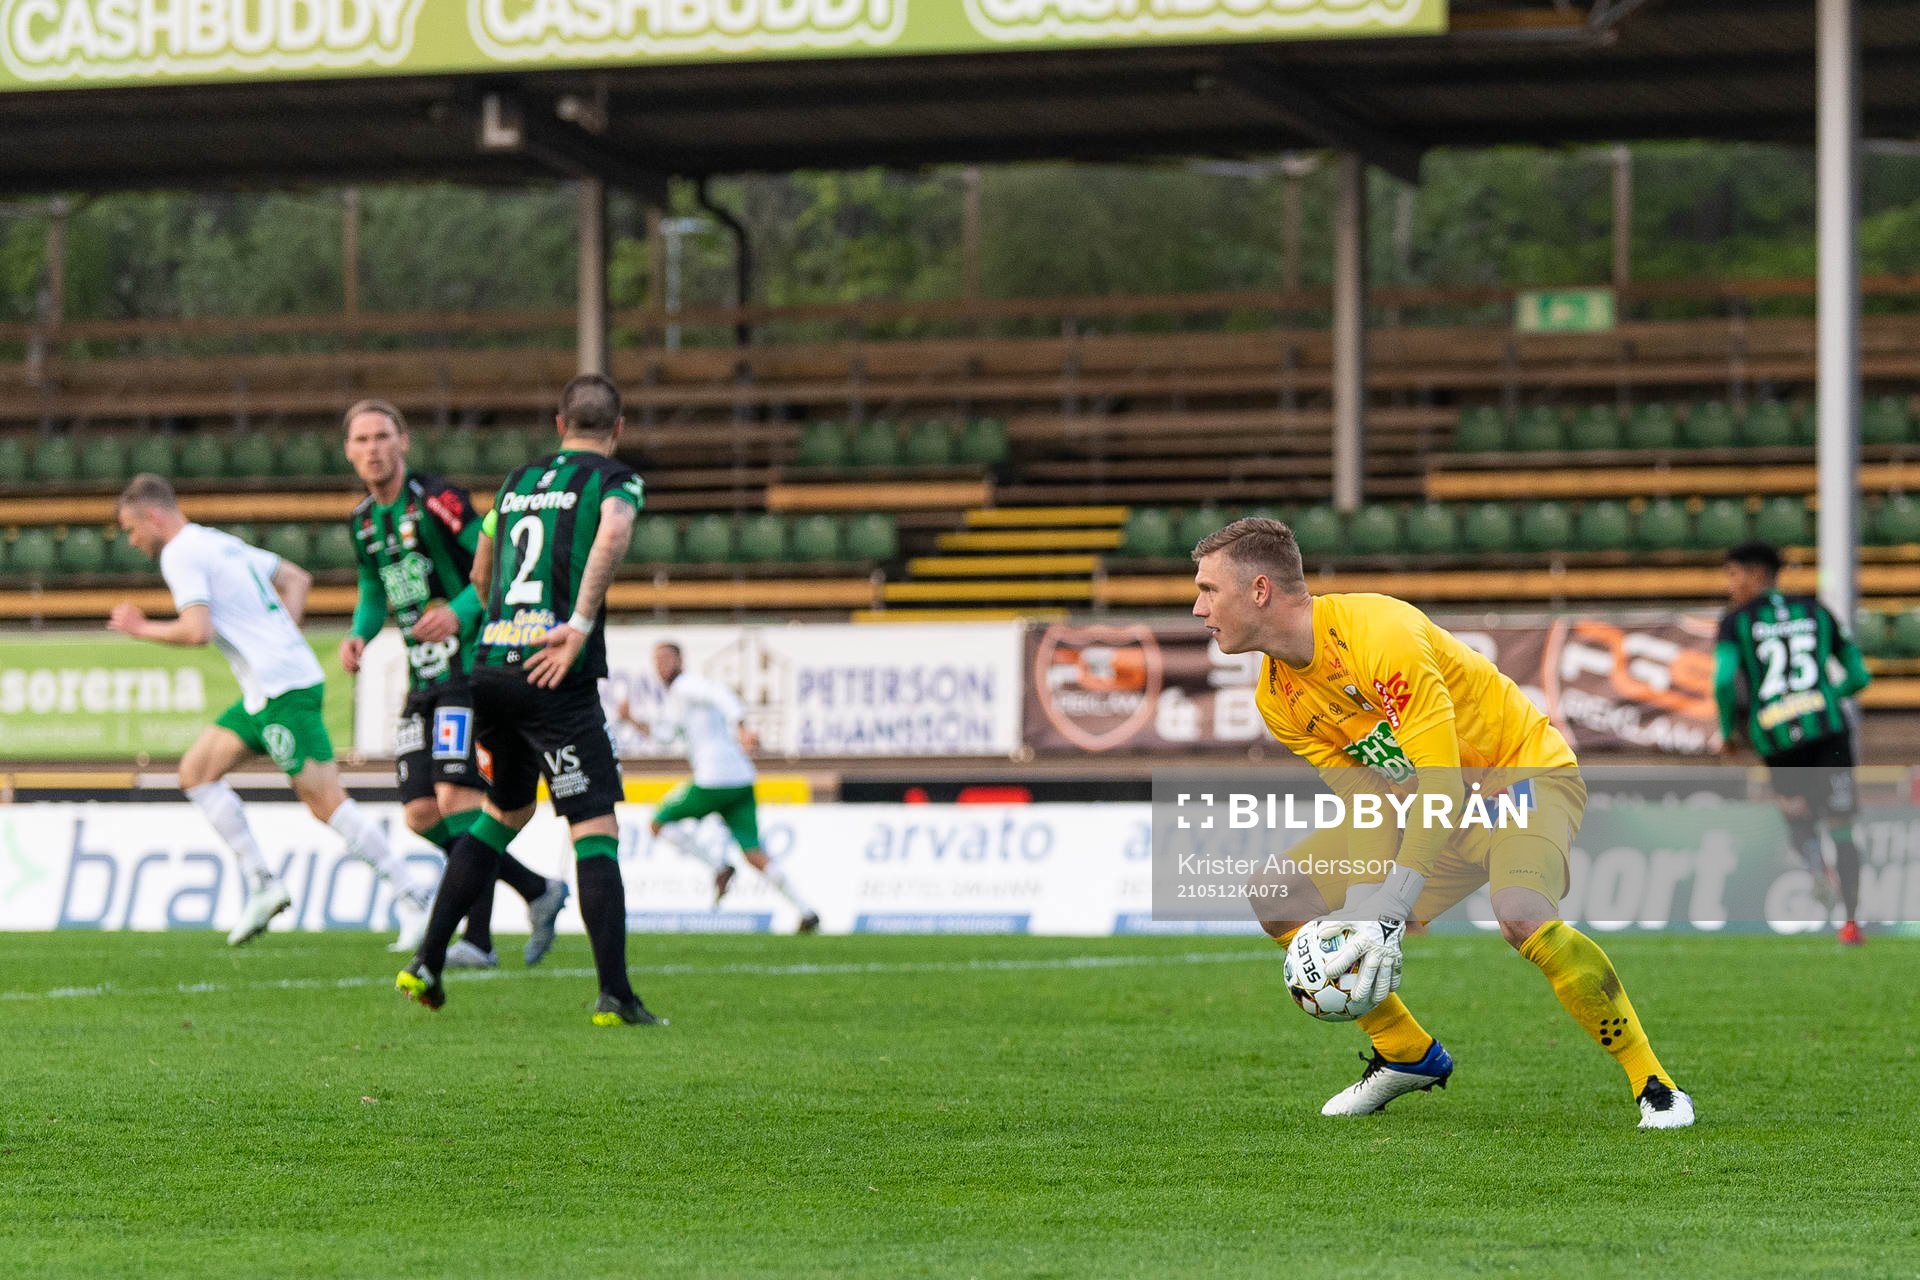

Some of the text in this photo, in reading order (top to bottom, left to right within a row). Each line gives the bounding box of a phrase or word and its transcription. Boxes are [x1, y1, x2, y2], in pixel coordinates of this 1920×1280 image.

[14, 0, 404, 60] CASHBUDDY
[500, 491, 577, 514] Derome
[504, 515, 544, 606] 2
[797, 667, 994, 705] PETERSON
[1386, 671, 1412, 712] ICA
[1755, 636, 1818, 701] 25
[543, 744, 581, 775] VS
[864, 811, 1056, 863] arvato
